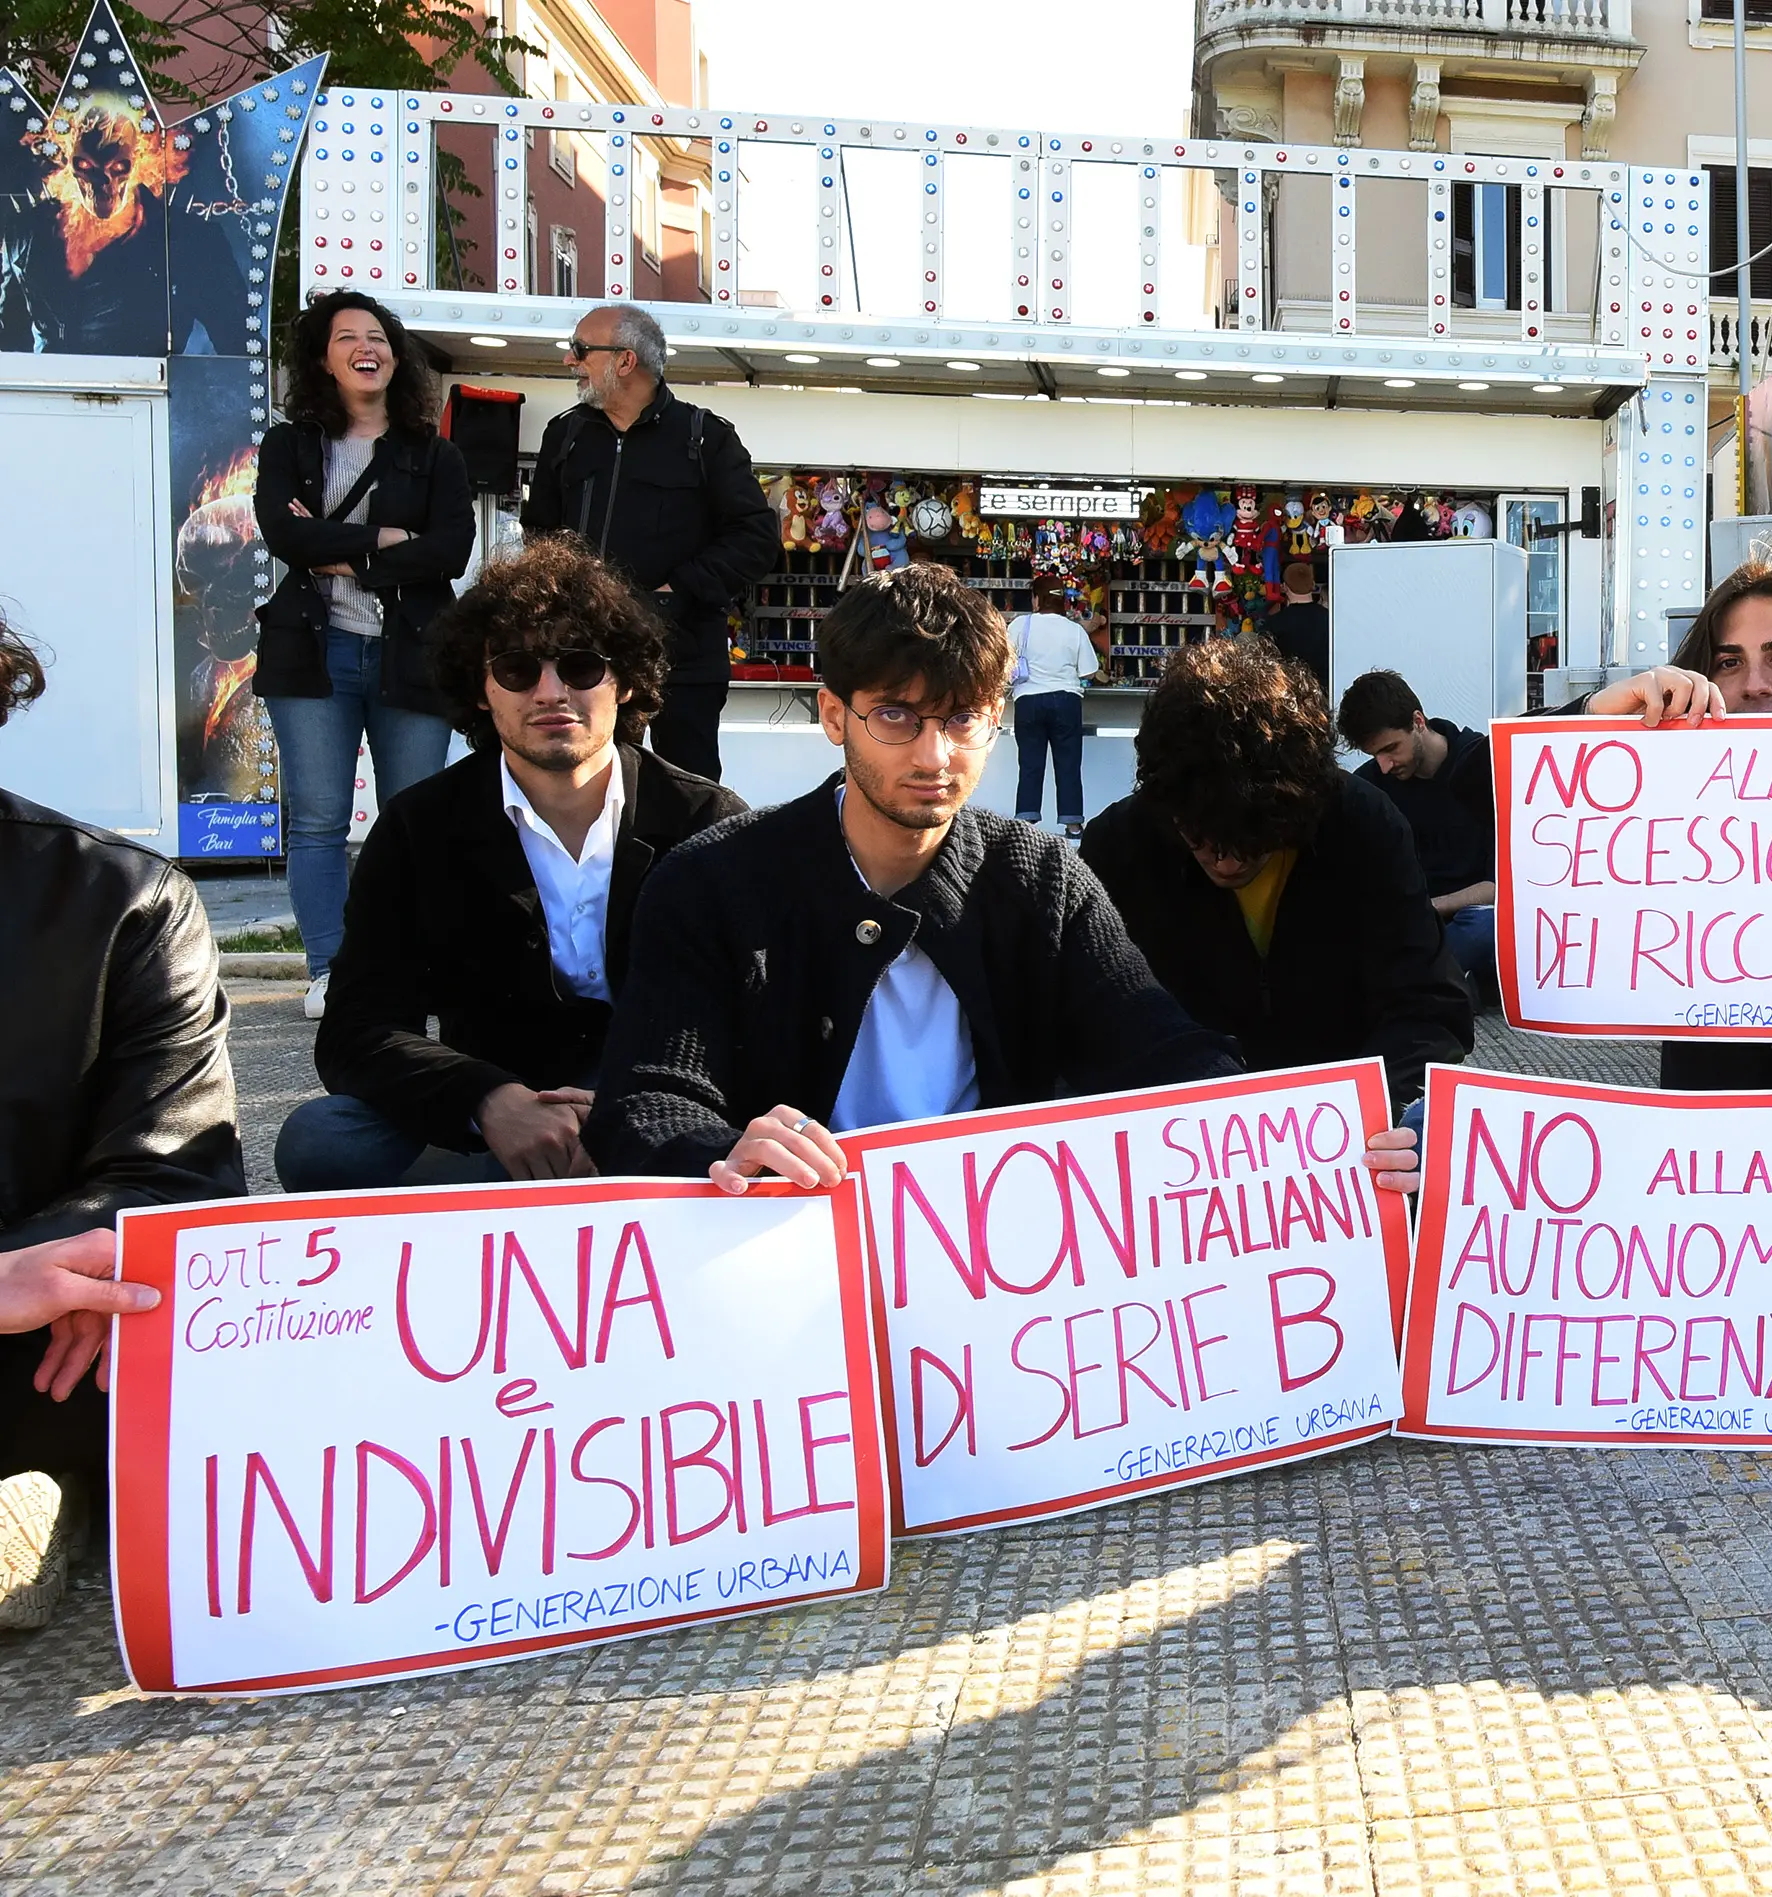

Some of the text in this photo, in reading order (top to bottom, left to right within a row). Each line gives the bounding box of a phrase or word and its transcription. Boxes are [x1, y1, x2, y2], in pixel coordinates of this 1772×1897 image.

[1017, 495, 1117, 517] sempre
[774, 641, 812, 651] VINCE
[1113, 646, 1165, 656] SI VINCE
[1525, 740, 1643, 812] NO
[197, 807, 258, 829] Famiglia
[198, 832, 233, 852] Bari
[1536, 907, 1599, 990] DEI
[1461, 1107, 1772, 1214] NO ALLA
[892, 1102, 1350, 1310] NON SIAMO
[1148, 1166, 1372, 1268] ITALIANI
[187, 1226, 342, 1291] art. 5
[185, 1297, 376, 1353] Costituzione
[396, 1221, 675, 1384] UNA
[910, 1266, 1345, 1467] DI SERIE B
[495, 1377, 555, 1418] e
[1295, 1393, 1383, 1438] URBANA
[204, 1390, 856, 1620] INDIVISIBILE
[715, 1549, 851, 1601] URBANA
